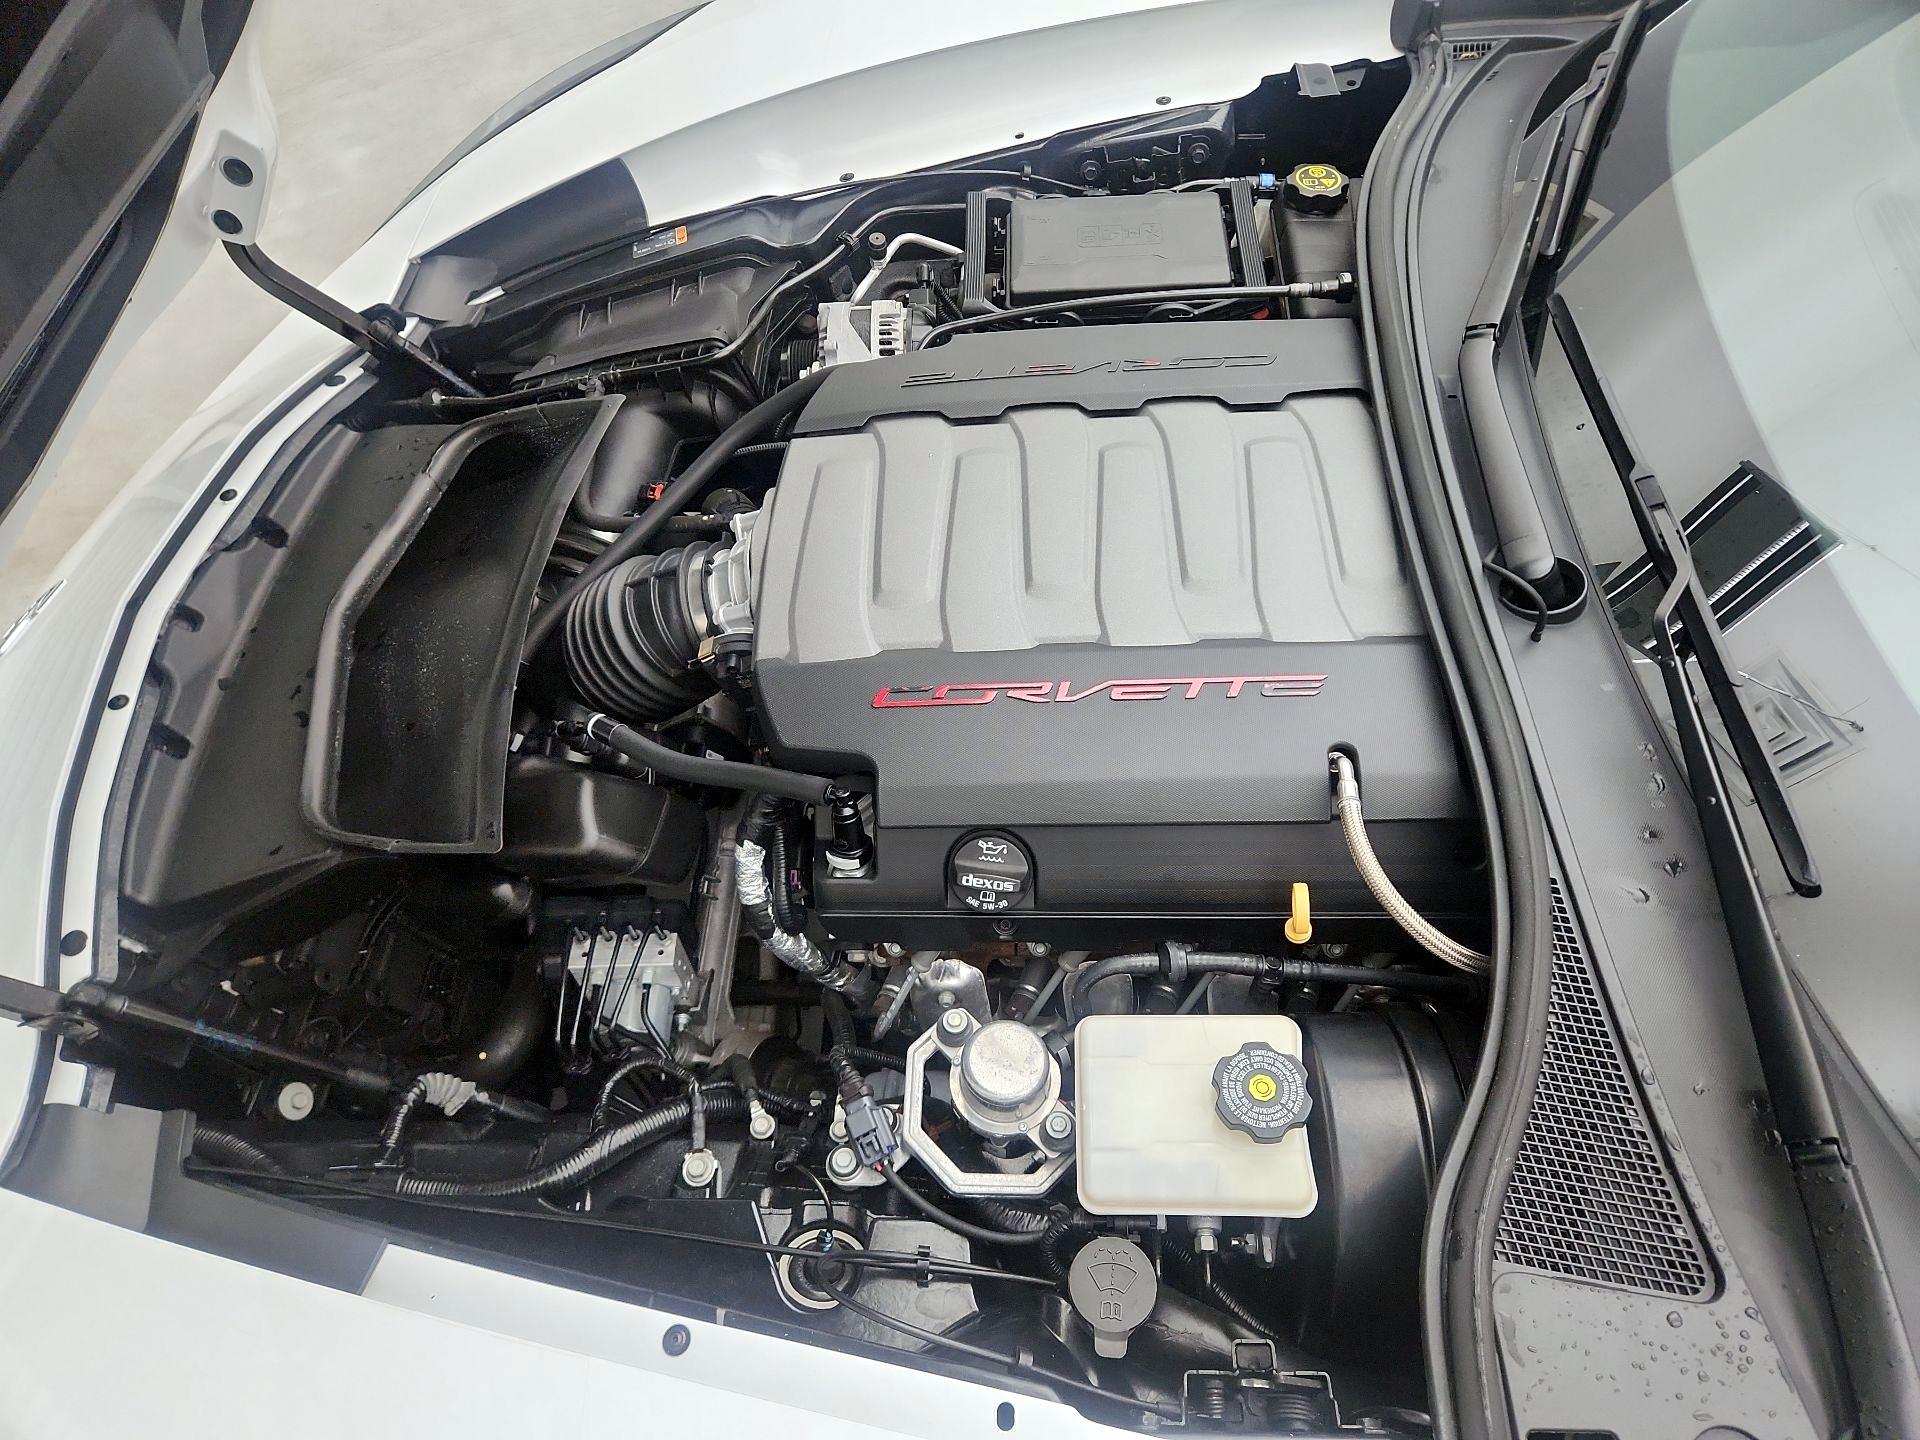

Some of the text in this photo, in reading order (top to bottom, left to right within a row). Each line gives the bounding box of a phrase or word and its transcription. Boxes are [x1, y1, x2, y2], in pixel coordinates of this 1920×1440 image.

[871, 674, 1328, 708] CORVETTE
[961, 874, 1016, 891] dexos
[966, 896, 1008, 910] SAE 5W-30
[1253, 1062, 1271, 1070] FILLER
[1263, 1056, 1274, 1065] USE
[1277, 1055, 1295, 1070] SEALED
[1225, 1065, 1234, 1073] LA
[1270, 1065, 1285, 1081] CLEAN
[1233, 1109, 1242, 1118] LE
[1240, 1105, 1248, 1114] DU
[1240, 1114, 1267, 1129] NETTOYER
